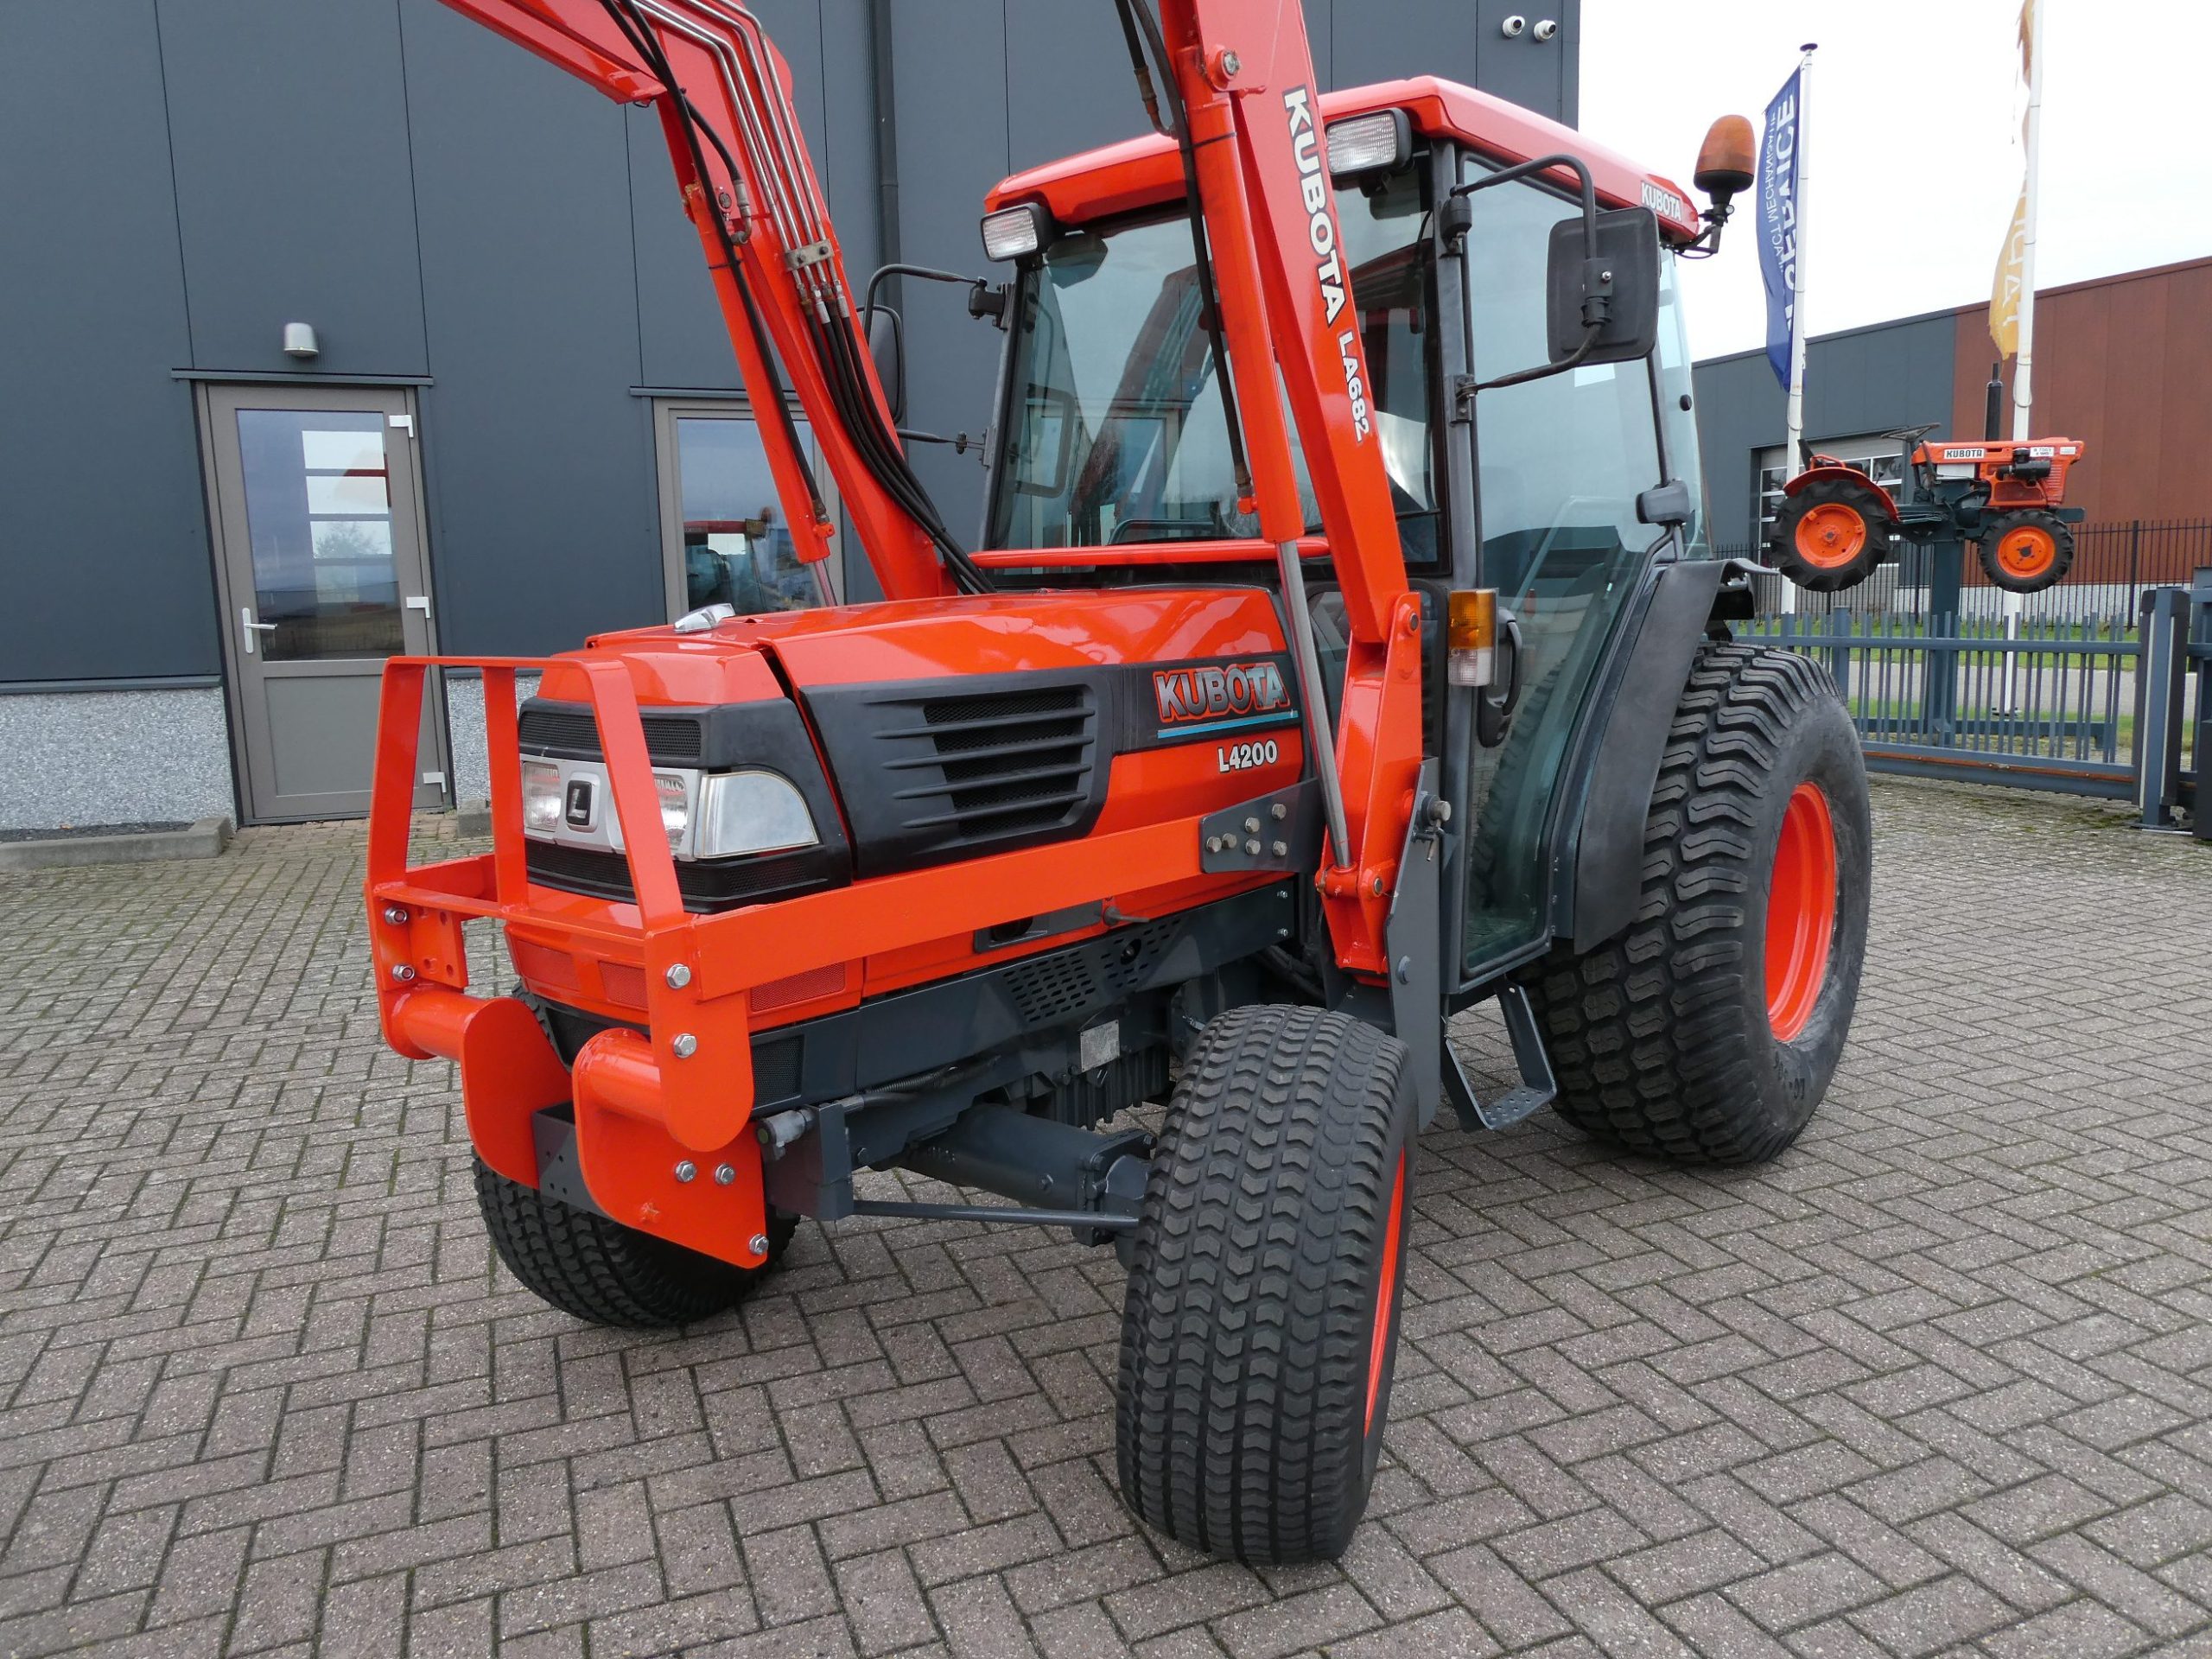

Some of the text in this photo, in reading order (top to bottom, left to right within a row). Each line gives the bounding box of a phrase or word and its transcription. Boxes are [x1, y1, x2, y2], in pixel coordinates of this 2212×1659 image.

[1641, 181, 1681, 221] KUBOTA
[1283, 88, 1370, 442] KUBOTA LA682
[1946, 449, 1982, 458] KUBOTA
[1155, 664, 1289, 719] KUBOTA
[1217, 740, 1278, 772] L4200
